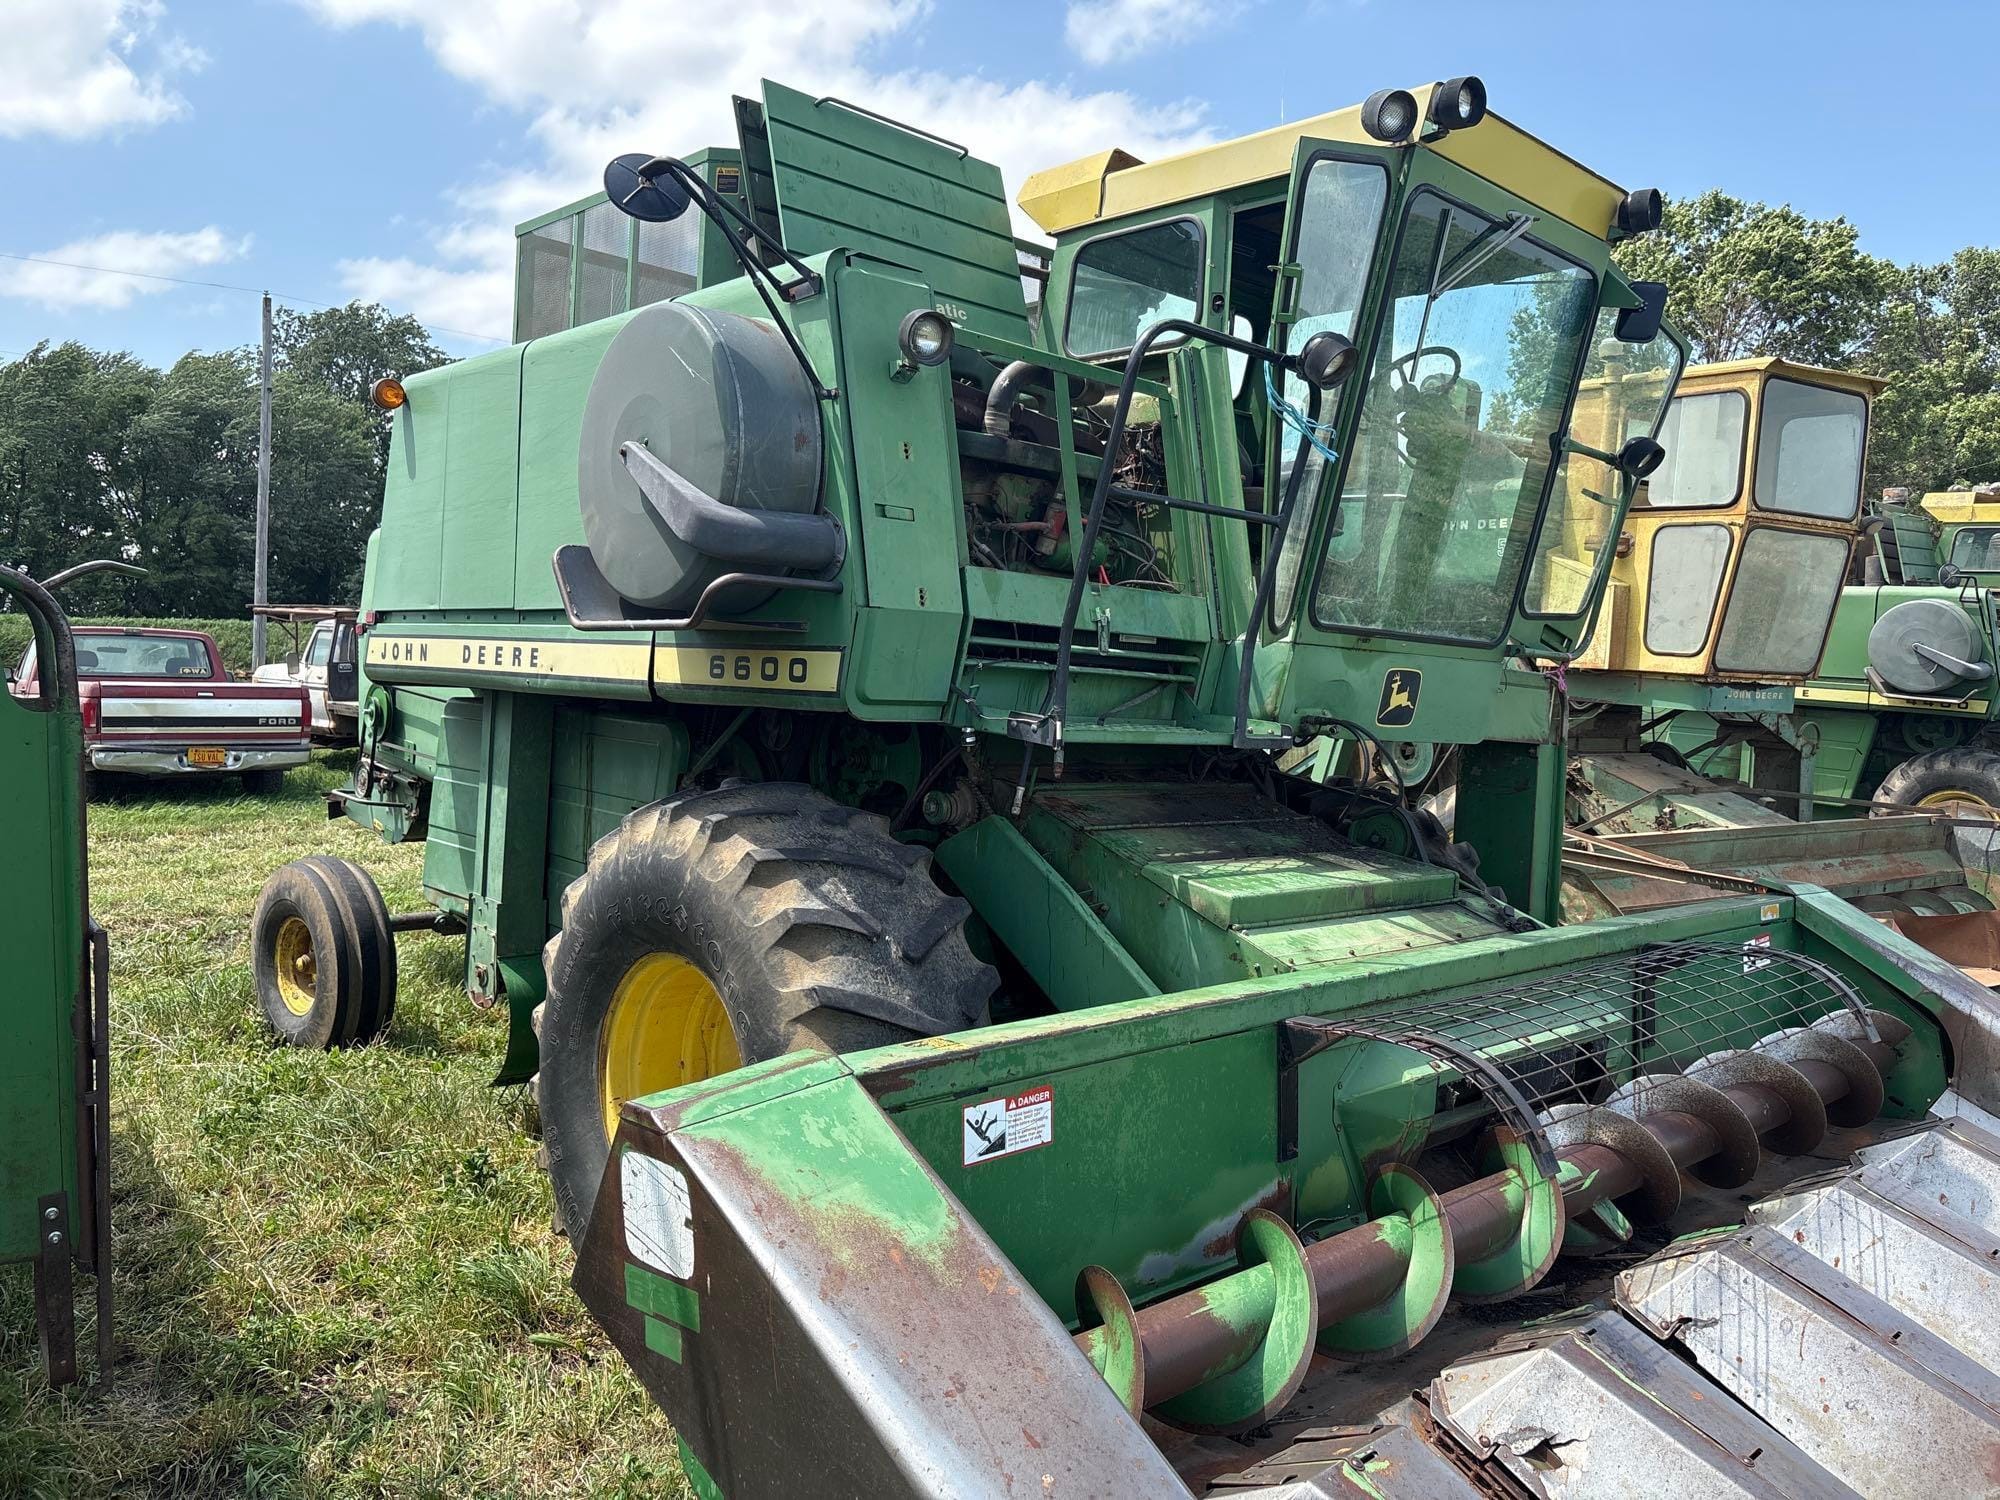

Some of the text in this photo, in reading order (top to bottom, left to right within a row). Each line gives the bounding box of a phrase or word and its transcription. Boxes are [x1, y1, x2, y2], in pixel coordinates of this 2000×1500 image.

[935, 303, 968, 320] atic
[1477, 518, 1513, 530] DEE
[381, 642, 539, 668] JOHN DEERE
[709, 655, 808, 683] 6600
[606, 895, 752, 1041] Firestone
[1017, 1091, 1050, 1107] DANGER
